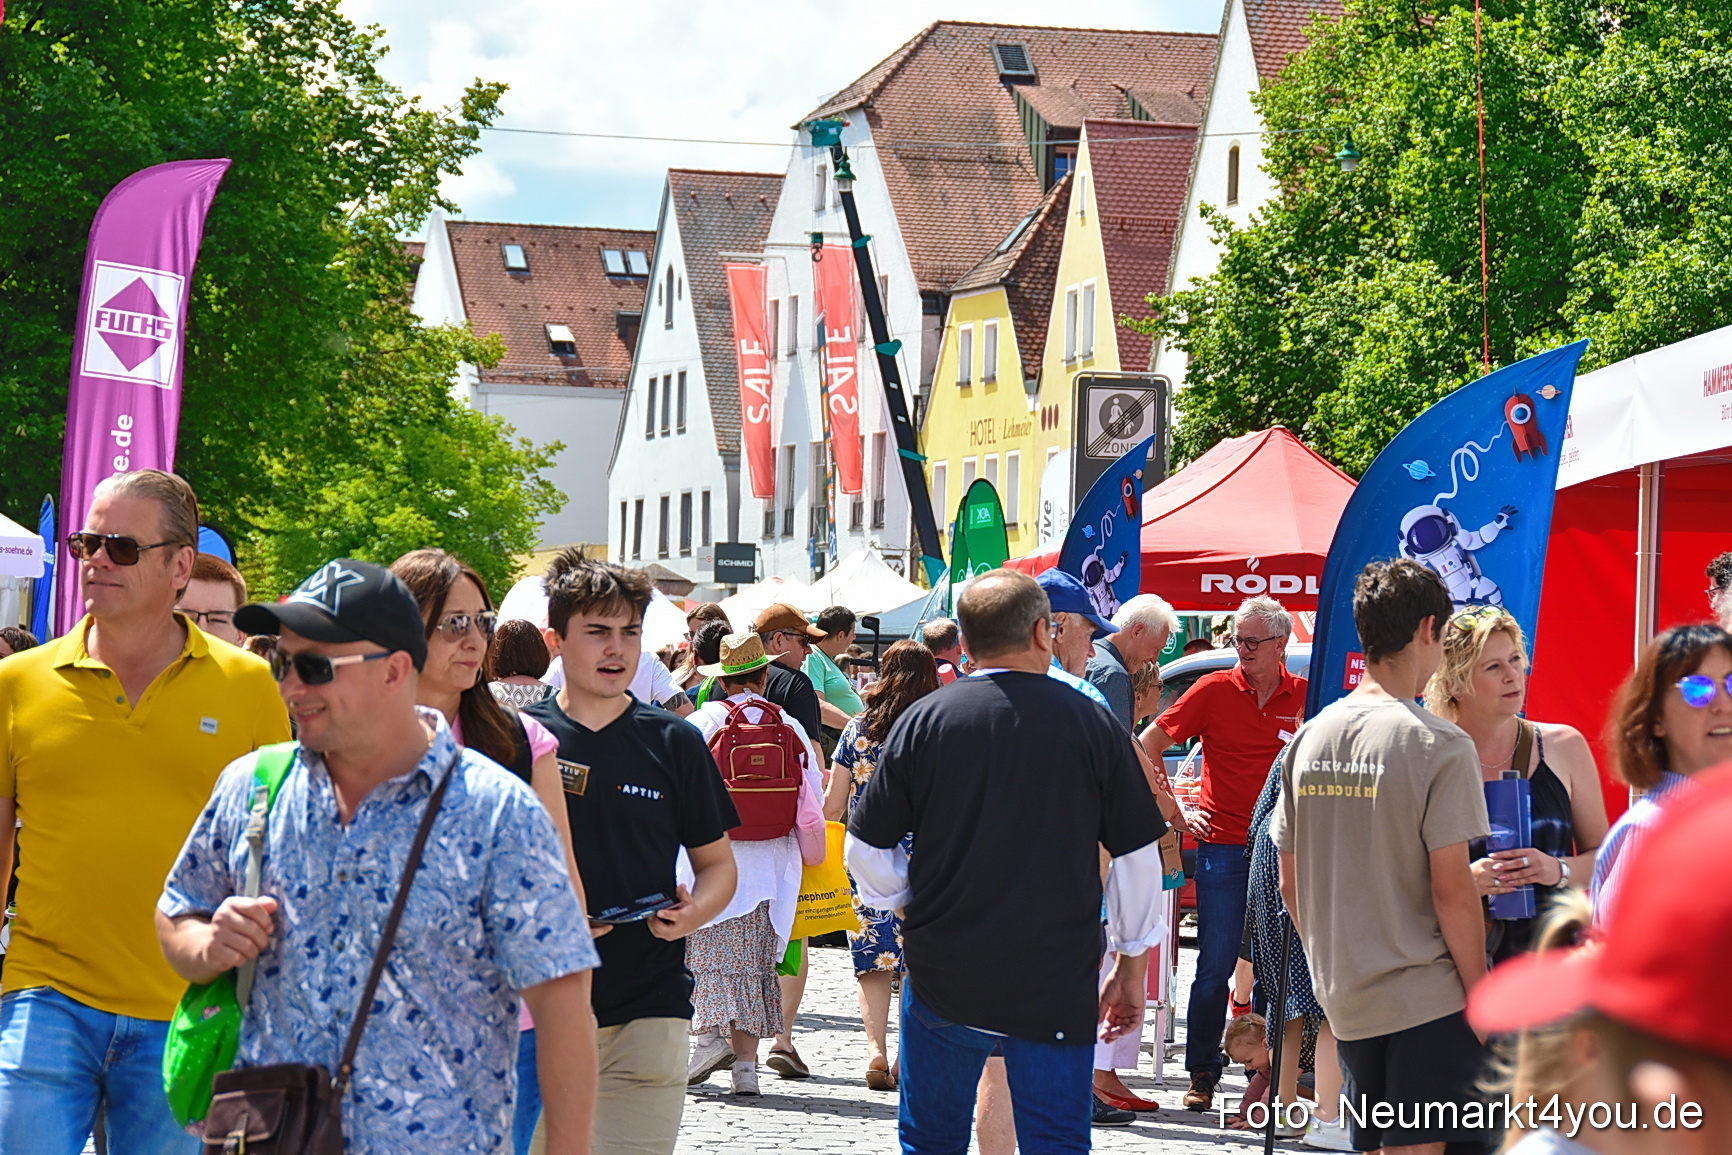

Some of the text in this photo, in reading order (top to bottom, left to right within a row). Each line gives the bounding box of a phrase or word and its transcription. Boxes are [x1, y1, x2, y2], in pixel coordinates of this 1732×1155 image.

[94, 310, 173, 339] FUCHS
[741, 338, 771, 424] SALE
[110, 414, 134, 477] e.de
[970, 416, 1032, 446] HOTEL Lehmeier
[718, 559, 754, 567] SCHMID
[1350, 658, 1366, 670] NE
[622, 784, 661, 800] APTIV
